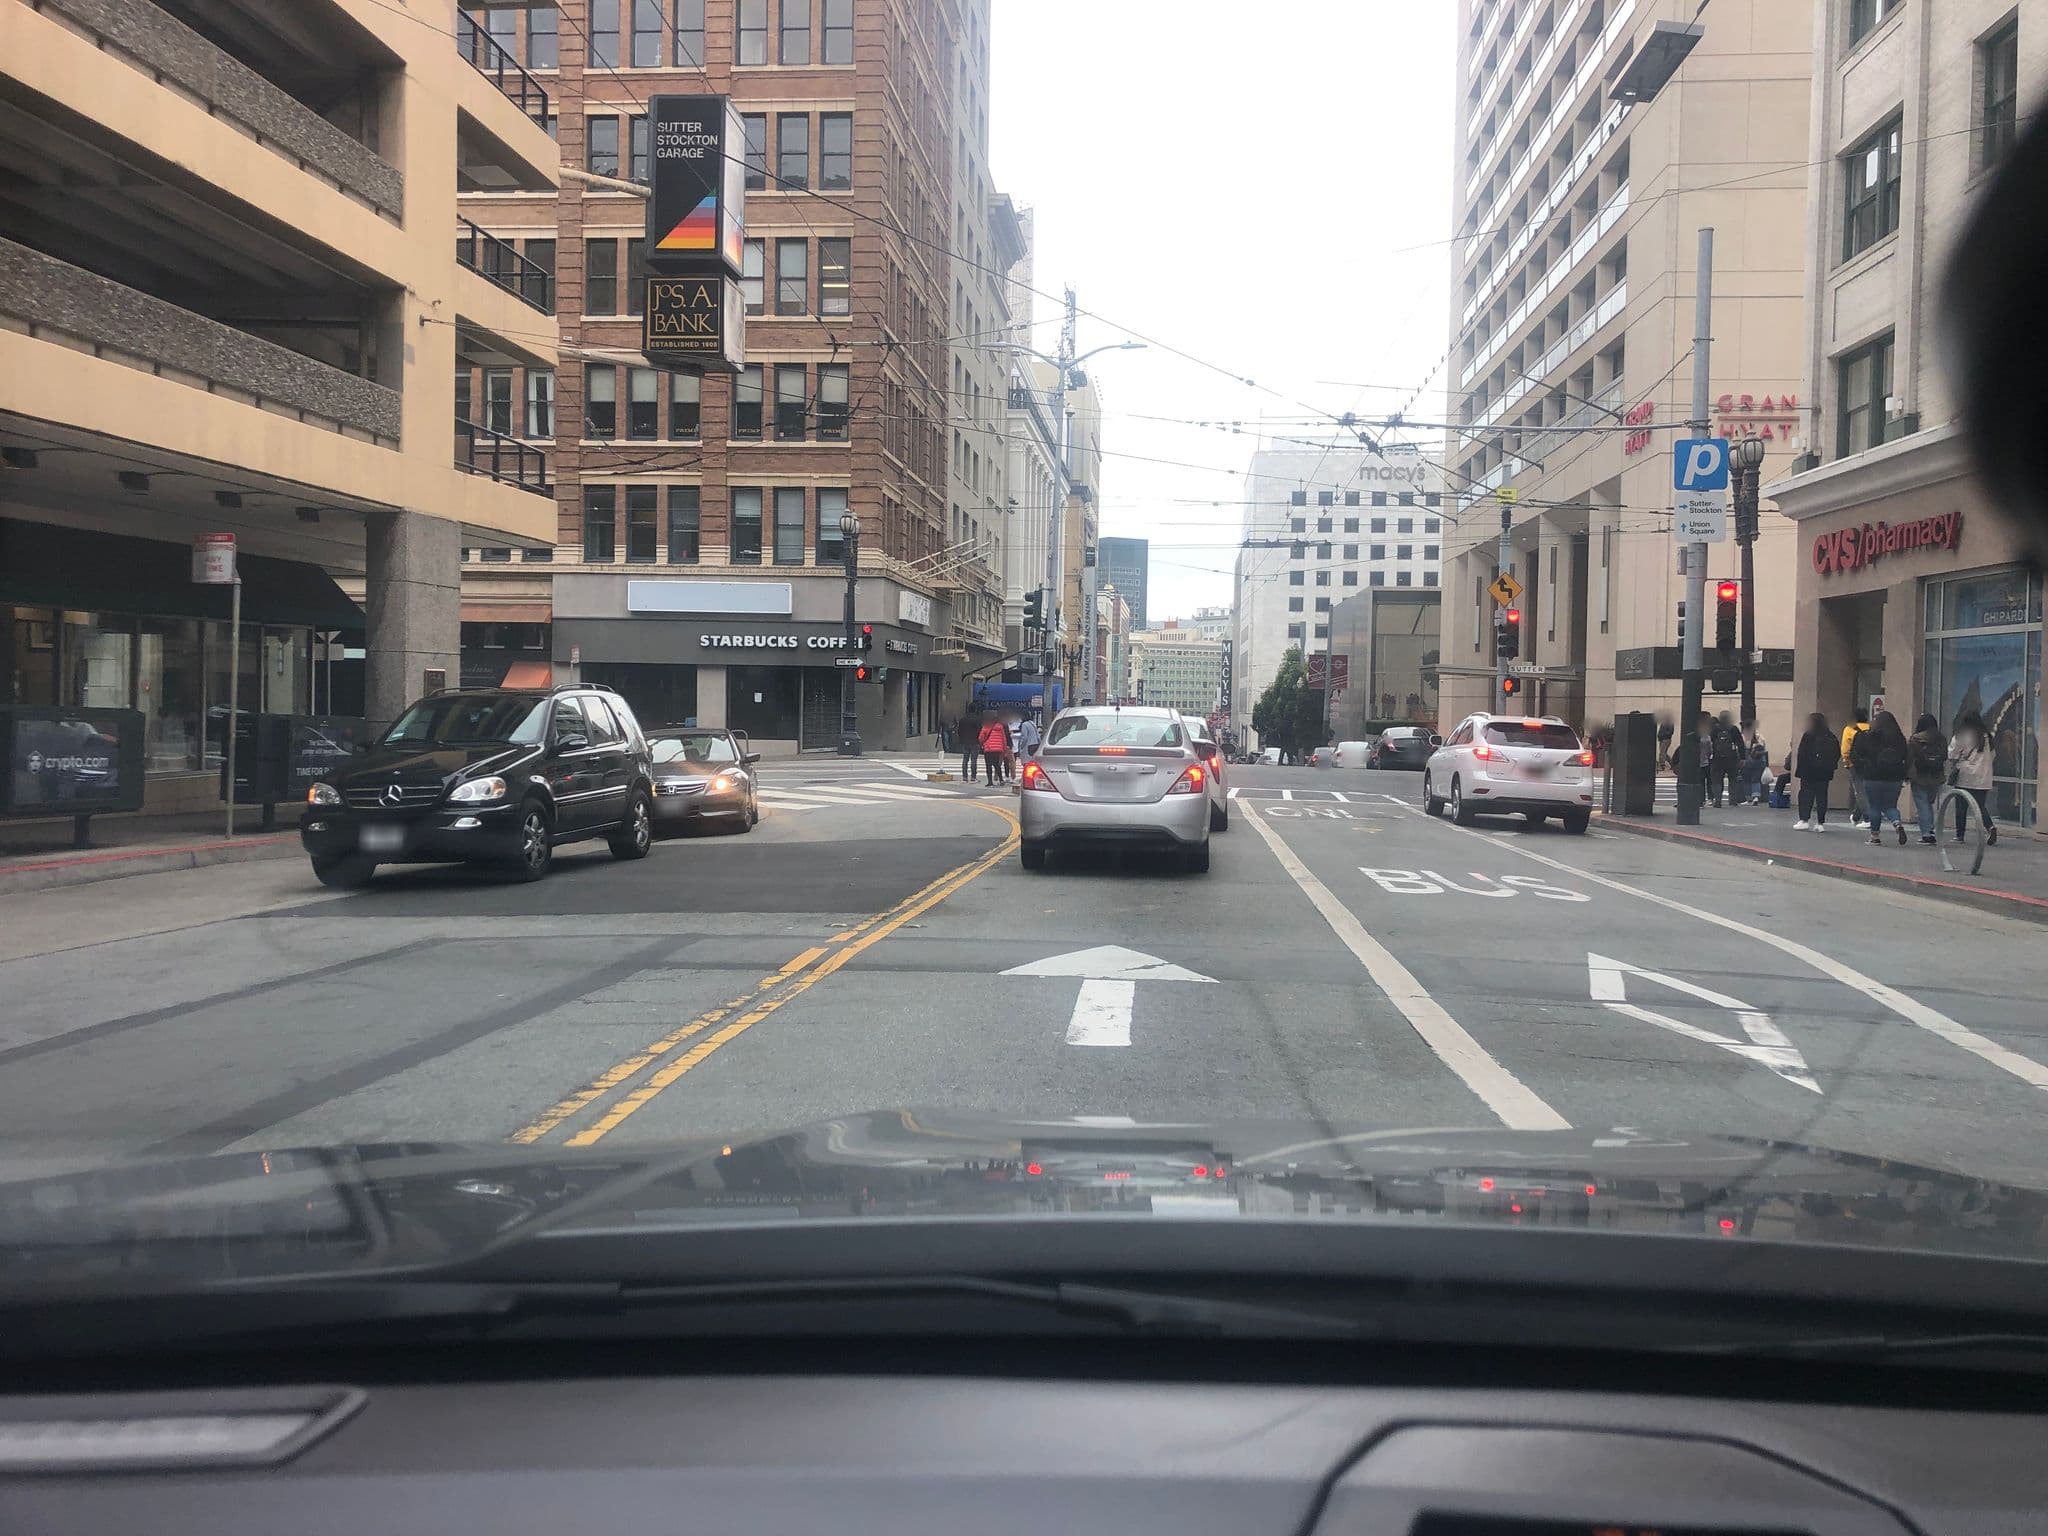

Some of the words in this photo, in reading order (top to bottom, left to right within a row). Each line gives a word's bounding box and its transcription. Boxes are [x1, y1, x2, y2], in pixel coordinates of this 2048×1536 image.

[657, 121, 702, 133] SUTTER
[657, 134, 718, 146] STOCKTON
[656, 147, 705, 159] GARAGE
[655, 313, 715, 333] BANK
[650, 341, 700, 349] ESTABLISHED
[1717, 394, 1797, 413] GRAN
[1718, 423, 1800, 441] HYAT
[1359, 463, 1426, 481] macy's
[1689, 500, 1716, 508] Sutter-
[1689, 528, 1716, 536] Square
[699, 635, 798, 649] STARBUCKS
[807, 636, 863, 649] COFF
[1510, 665, 1544, 673] SUTTER
[45, 756, 109, 771] crypto.com
[1357, 865, 1592, 904] BUS
